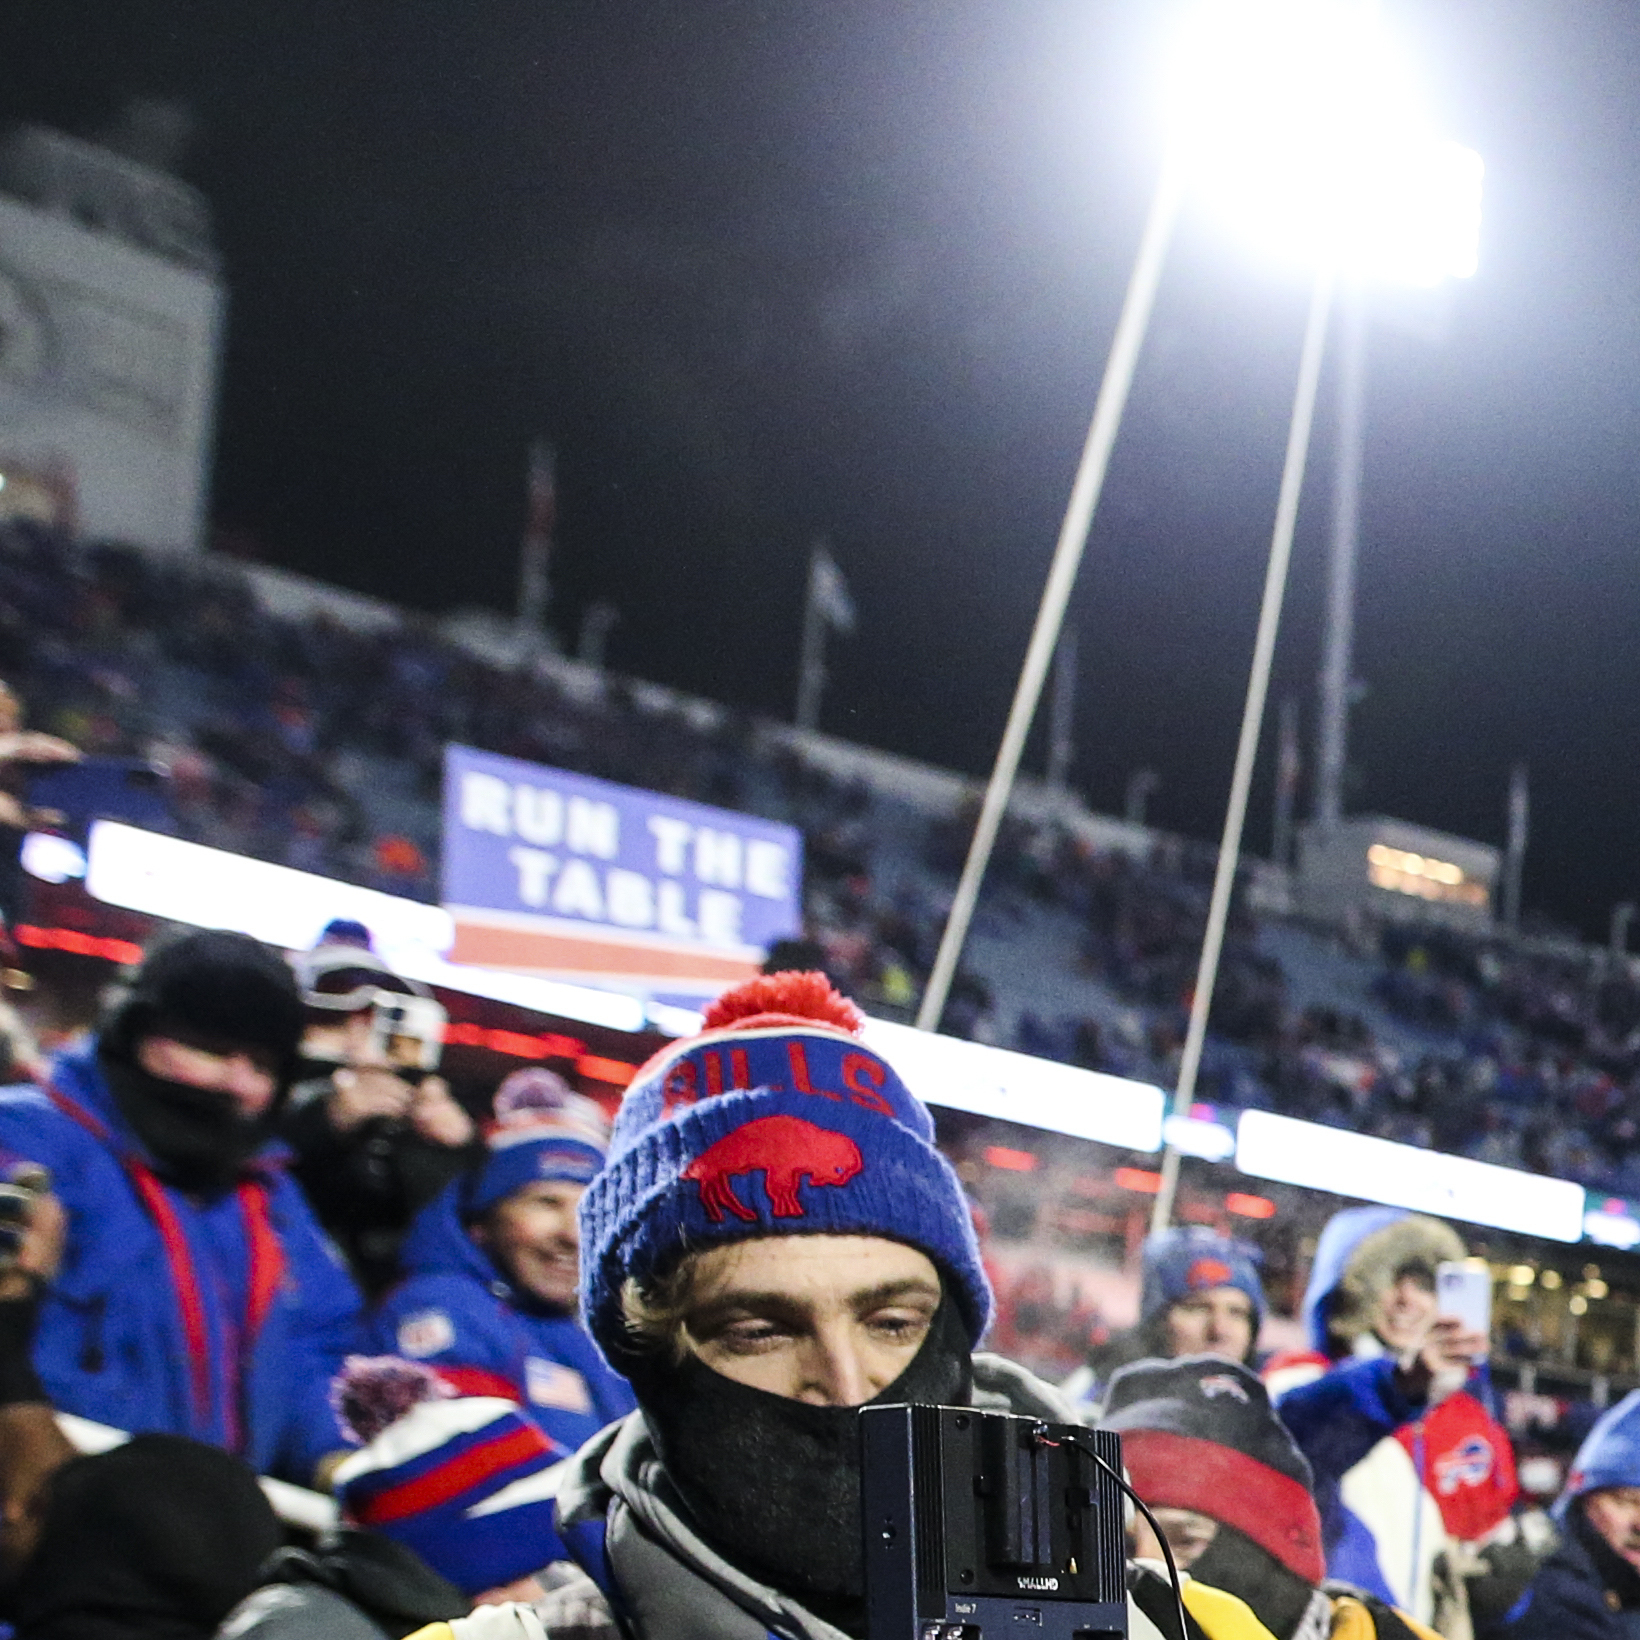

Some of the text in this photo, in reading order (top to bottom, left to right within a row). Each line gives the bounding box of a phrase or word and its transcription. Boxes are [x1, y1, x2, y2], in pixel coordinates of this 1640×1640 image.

[460, 771, 790, 901] RUN THE
[510, 846, 745, 946] TABLE
[661, 1041, 898, 1118] BILLS
